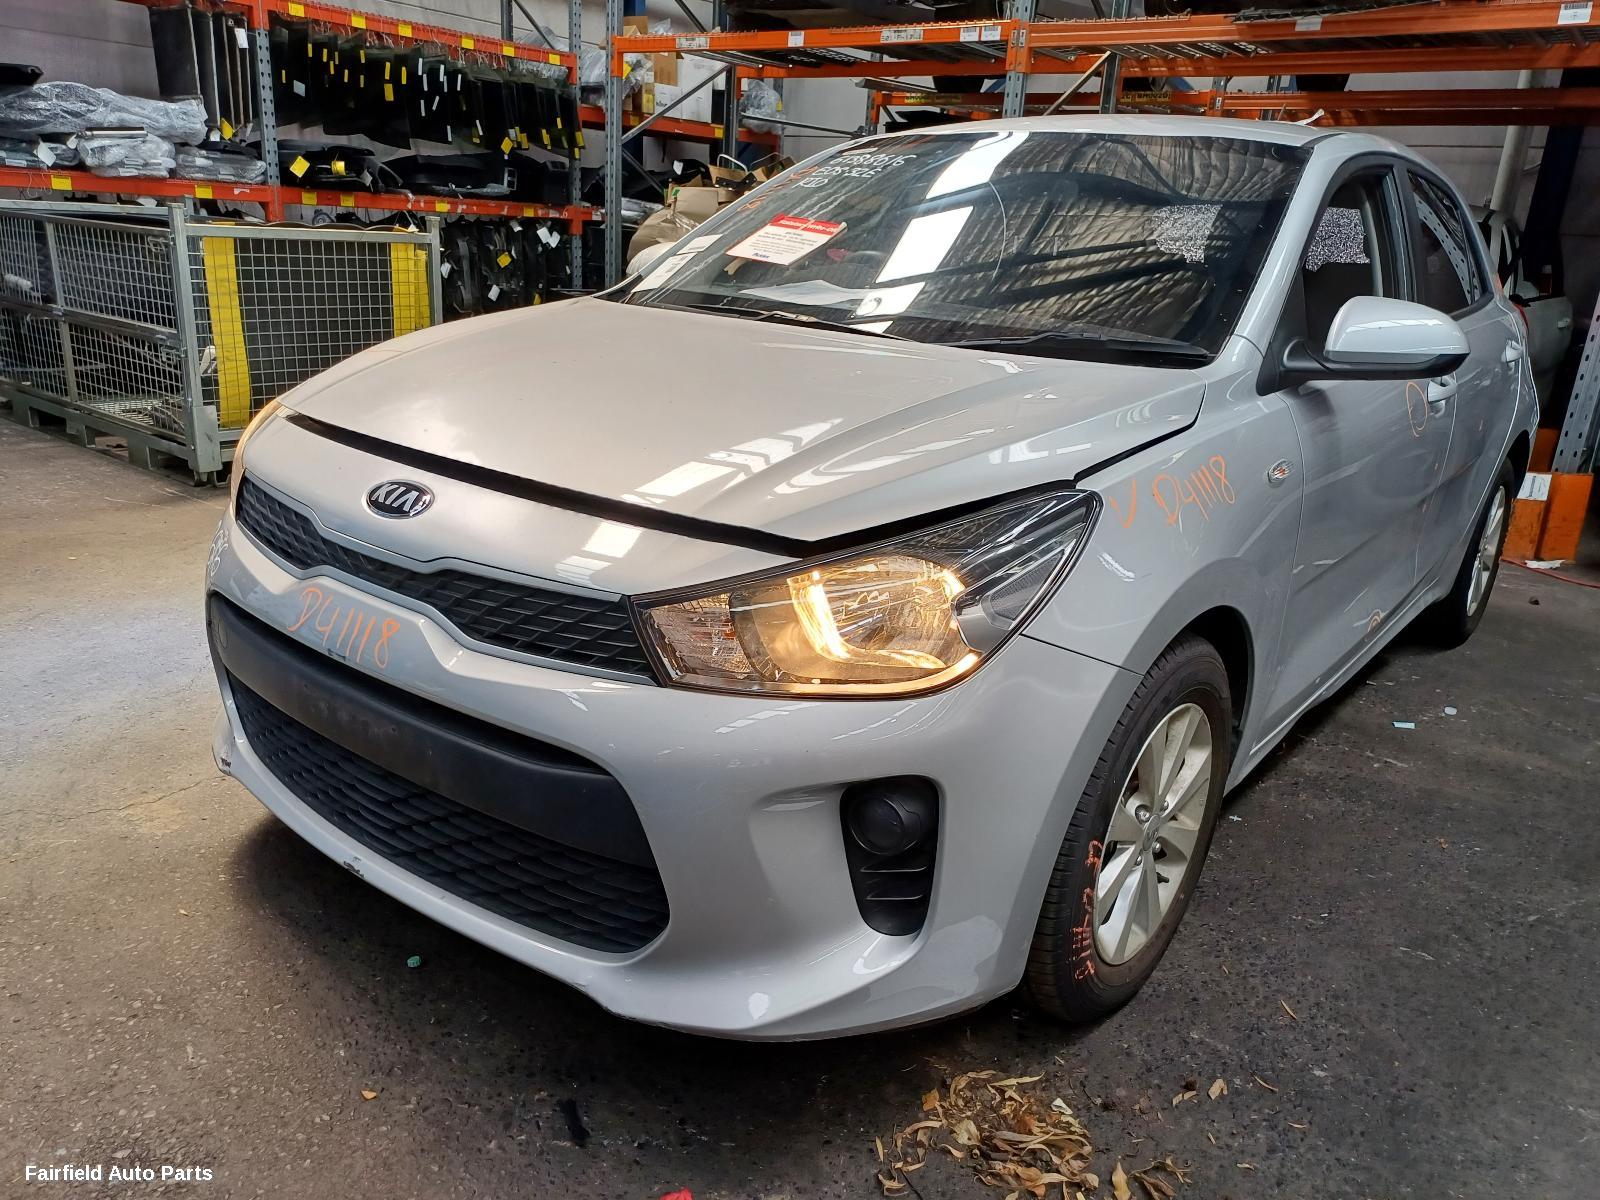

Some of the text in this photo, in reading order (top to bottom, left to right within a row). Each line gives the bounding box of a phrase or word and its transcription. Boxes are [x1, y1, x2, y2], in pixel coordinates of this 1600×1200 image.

[371, 483, 420, 512] KIA
[1153, 455, 1235, 526] D41118
[287, 587, 400, 669] D41118
